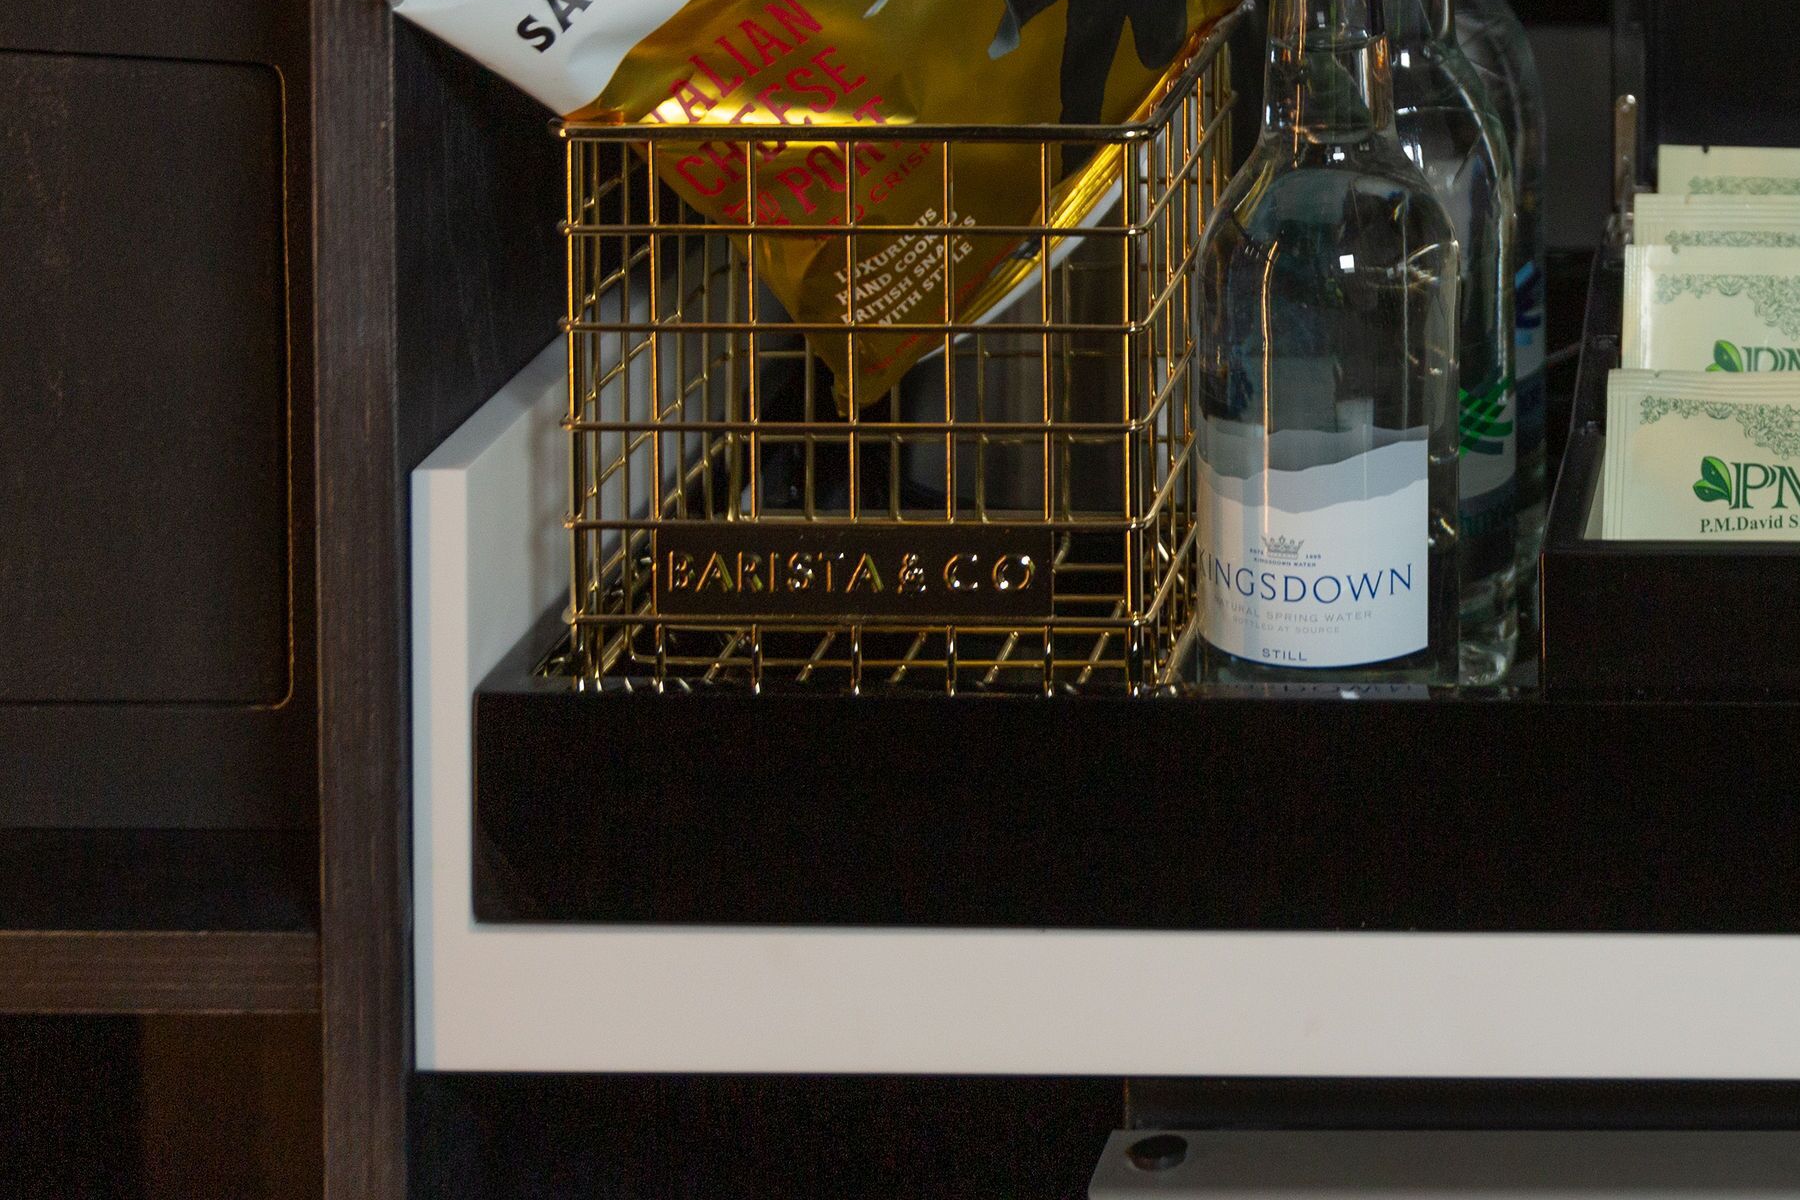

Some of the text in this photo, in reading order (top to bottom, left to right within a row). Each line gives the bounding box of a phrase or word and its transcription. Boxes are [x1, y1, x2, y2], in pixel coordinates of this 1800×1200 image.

[1700, 515, 1784, 533] P.M.David
[667, 550, 1036, 594] BARISTA & CO
[1199, 548, 1412, 604] KINGSDOWN
[1266, 610, 1319, 623] SPRING
[1323, 610, 1373, 623] WATER
[1295, 625, 1340, 635] SOURCE
[1261, 647, 1308, 662] STILL
